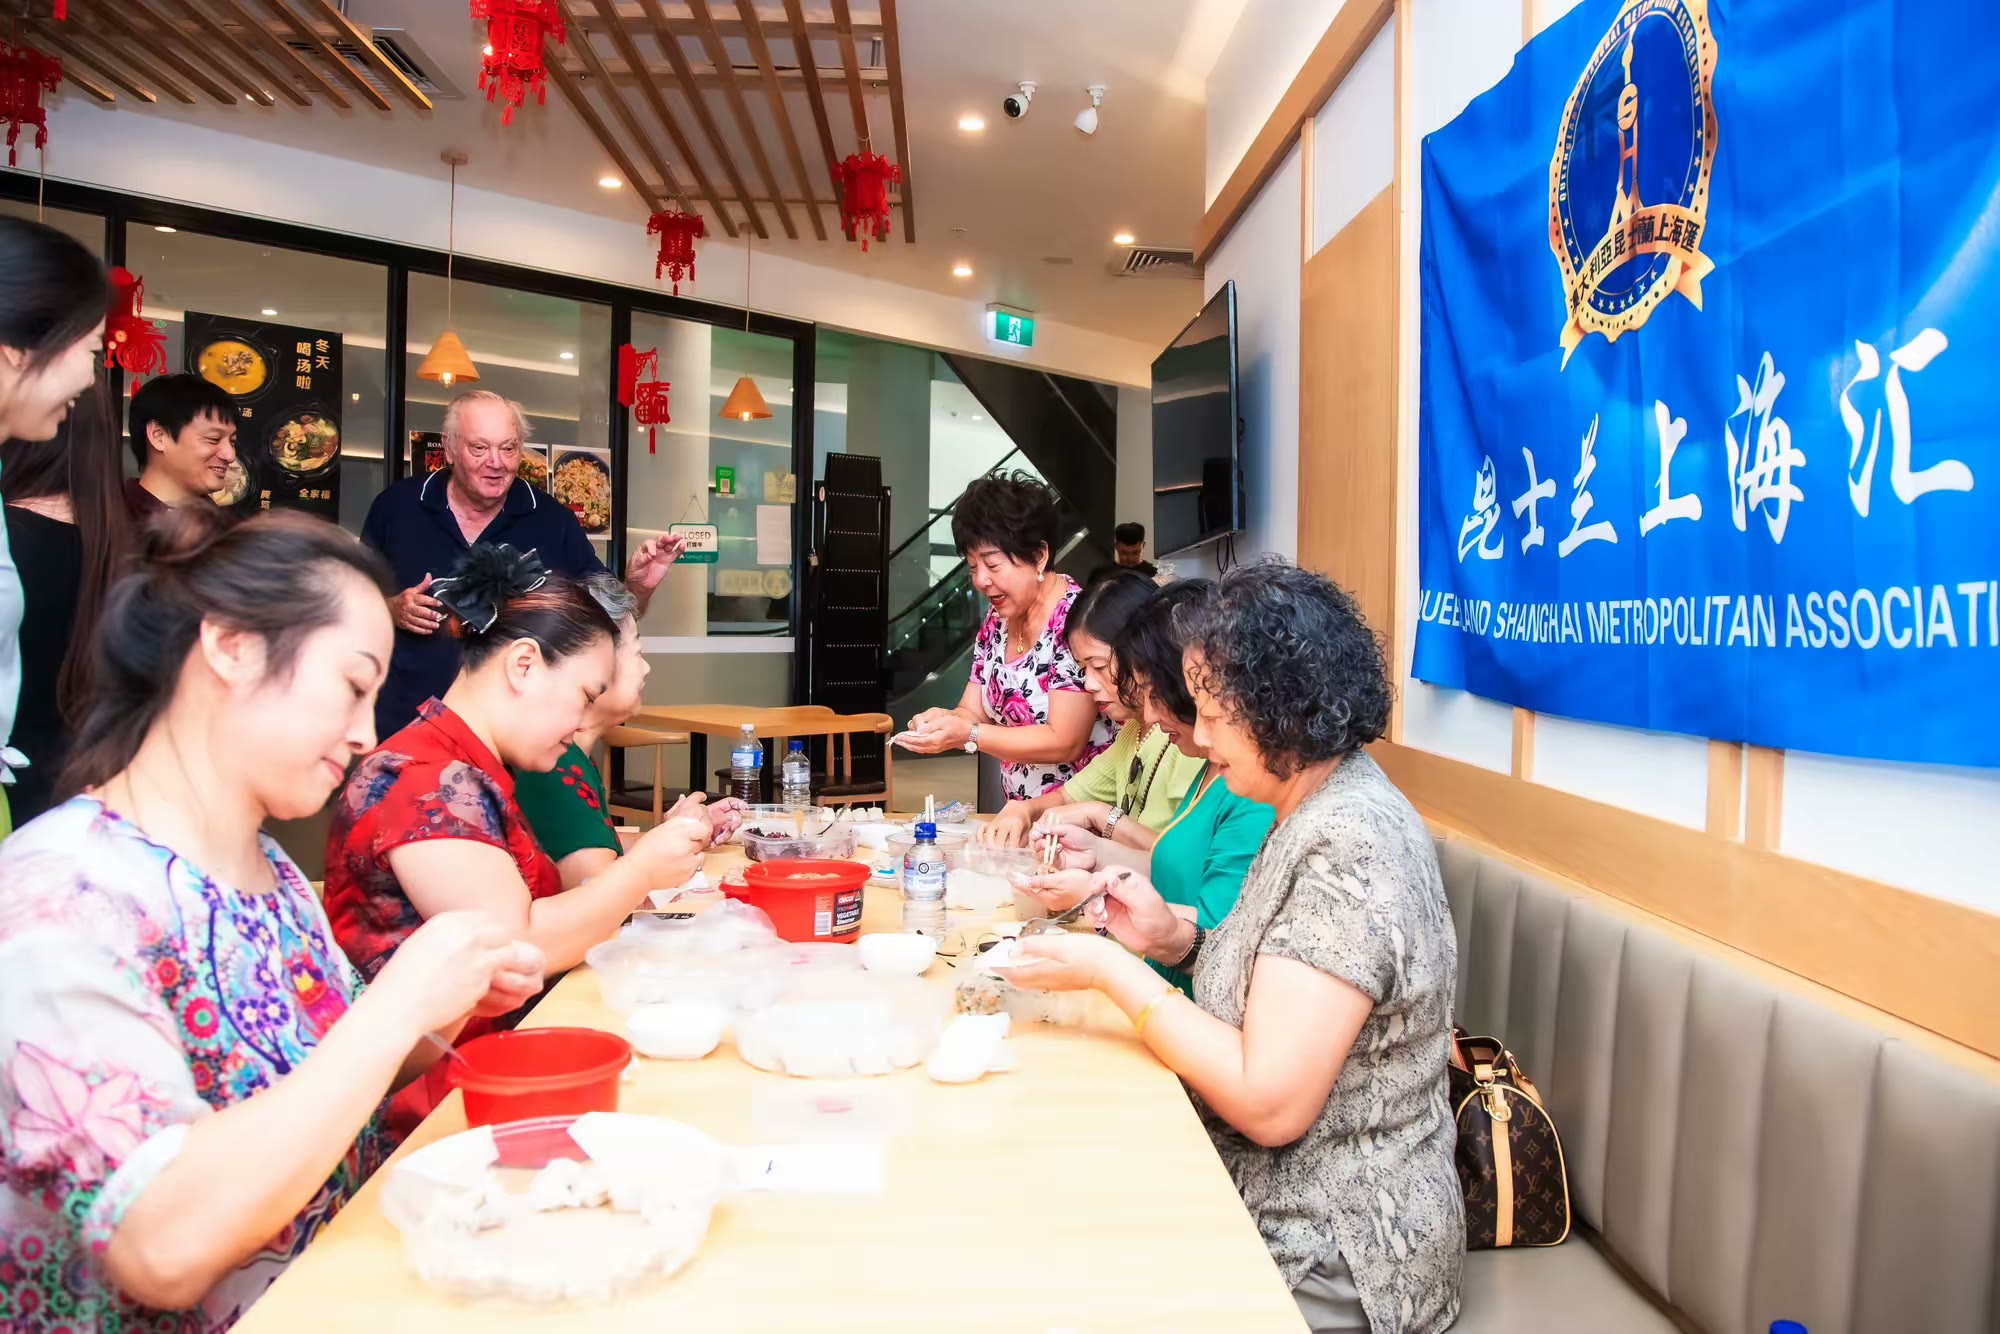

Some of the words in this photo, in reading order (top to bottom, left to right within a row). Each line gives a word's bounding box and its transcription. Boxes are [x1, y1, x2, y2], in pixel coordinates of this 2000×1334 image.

[296, 342, 312, 390] 喝汤啦
[315, 338, 331, 370] 冬天
[1493, 600, 1583, 644] SHANGHAI
[1586, 595, 1776, 648] METROPOLITAN
[1785, 580, 1999, 649] ASSOCIATI
